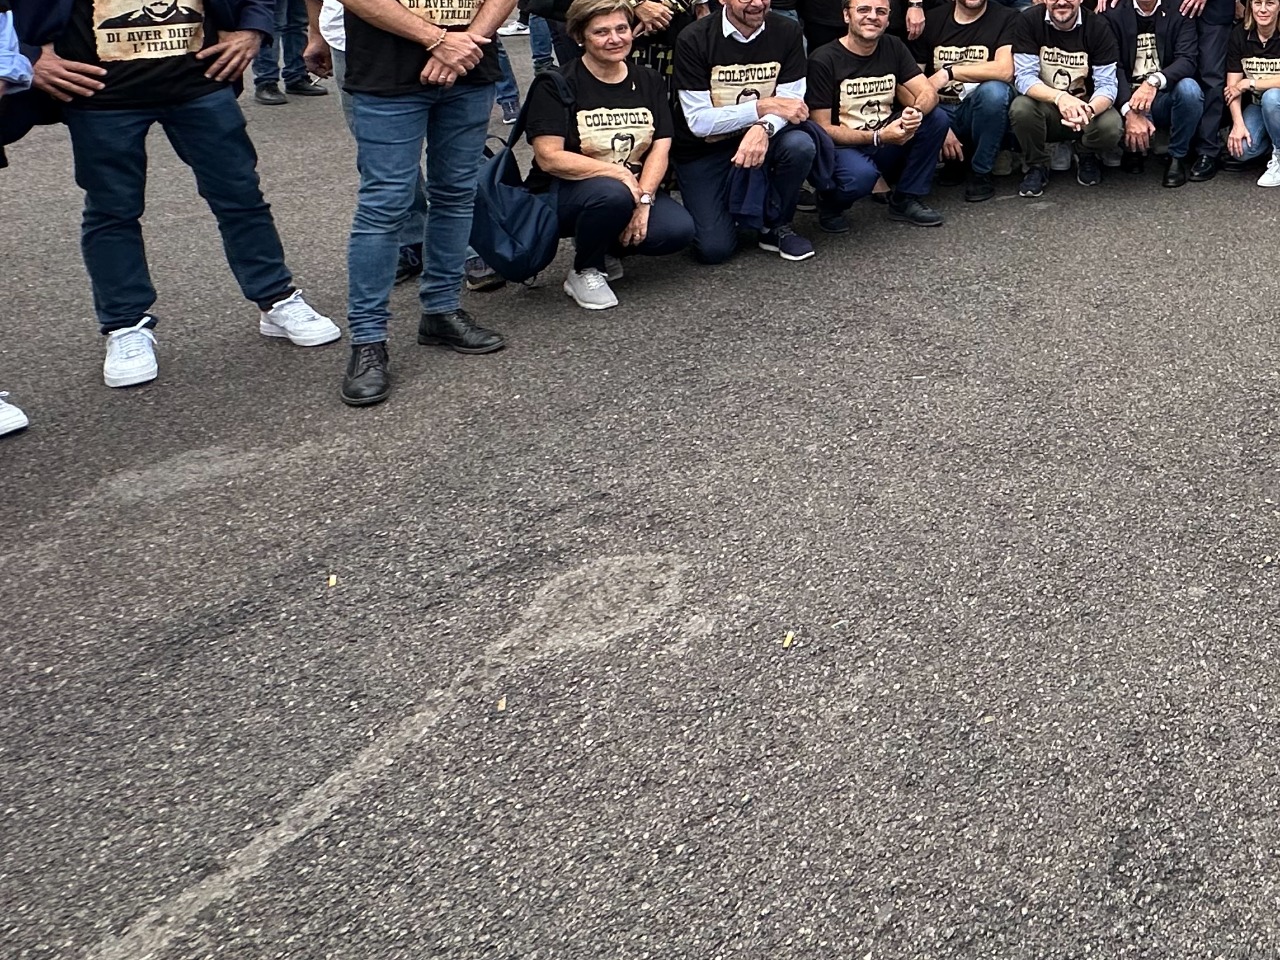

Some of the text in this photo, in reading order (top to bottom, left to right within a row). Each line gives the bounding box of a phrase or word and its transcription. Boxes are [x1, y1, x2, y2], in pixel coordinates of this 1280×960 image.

[429, 10, 471, 20] L'ITALIA
[106, 33, 121, 43] DI
[127, 29, 162, 42] AVER
[133, 39, 189, 54] L'ITALIA
[938, 48, 984, 61] COLPEVOLE
[718, 66, 777, 83] COLPEVOLE
[846, 78, 894, 95] COLPEVOLE
[585, 111, 649, 128] COLPEVOLE
